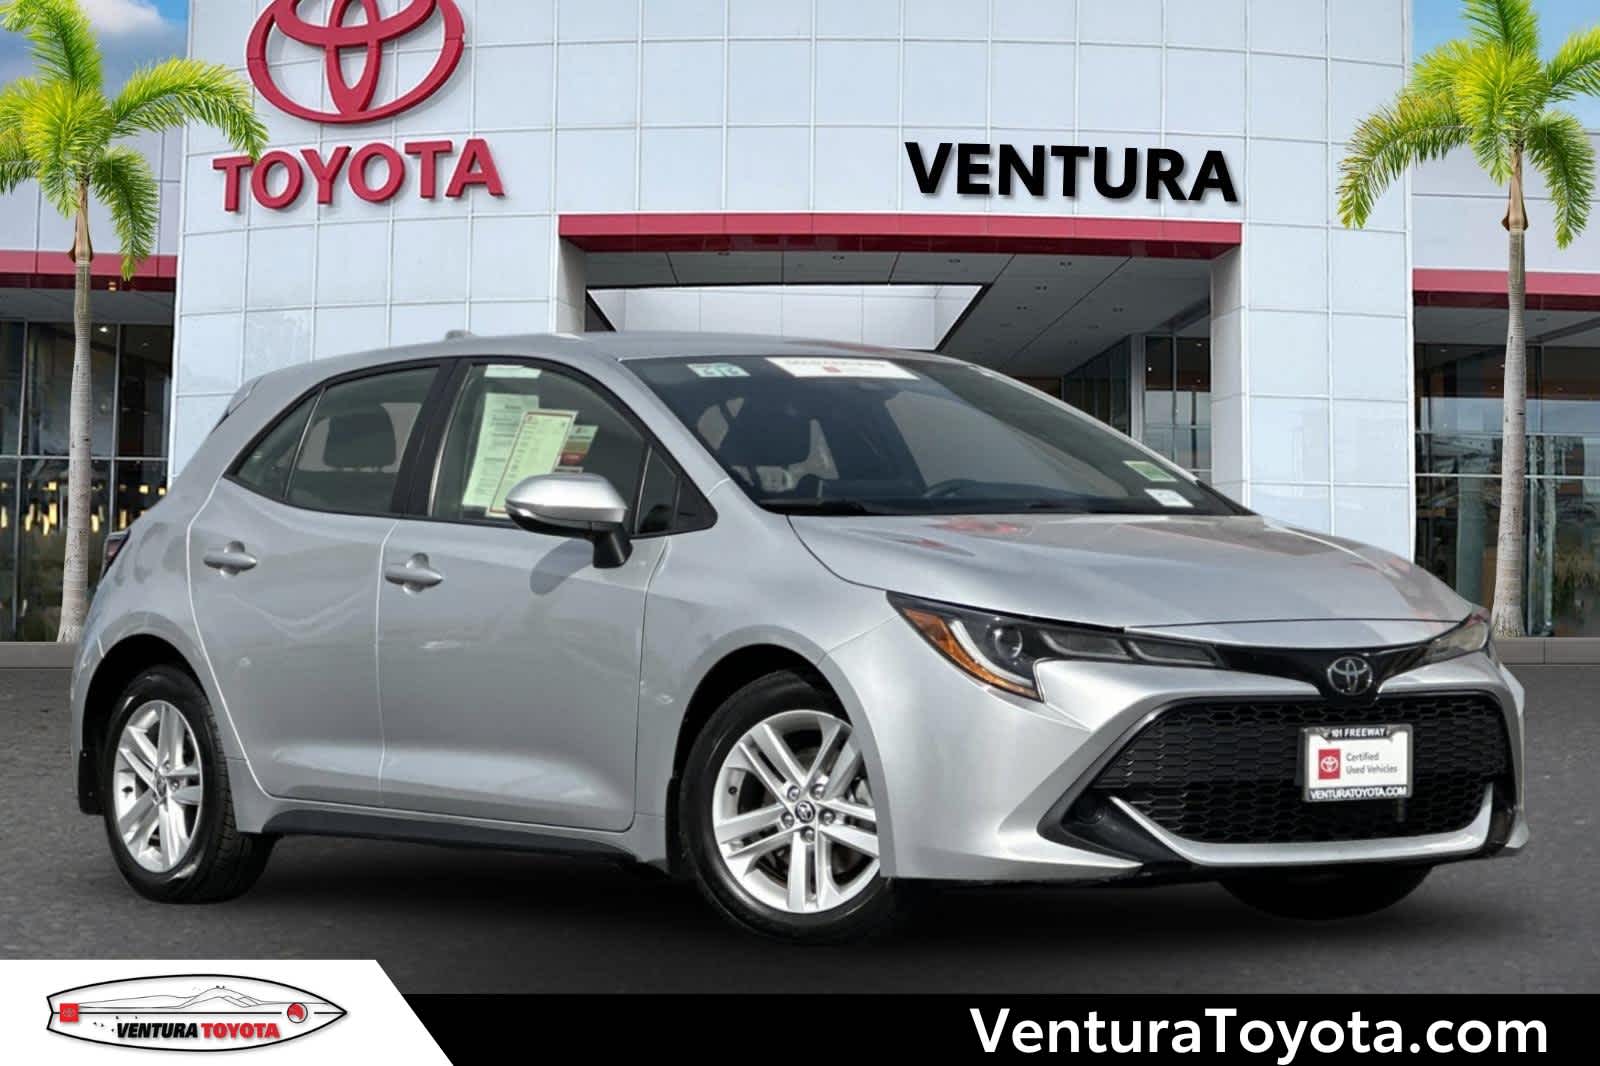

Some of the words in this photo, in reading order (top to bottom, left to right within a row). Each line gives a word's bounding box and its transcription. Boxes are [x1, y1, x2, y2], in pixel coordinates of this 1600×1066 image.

[212, 138, 505, 212] TOYOTA
[904, 141, 1238, 203] VENTURA
[1331, 728, 1343, 738] 101
[1344, 727, 1386, 737] FREEWAY
[1345, 752, 1380, 762] Certified
[1345, 766, 1365, 775] Used
[1367, 764, 1398, 774] Vehicles
[1310, 786, 1407, 800] VENTURATOYOTA.COM
